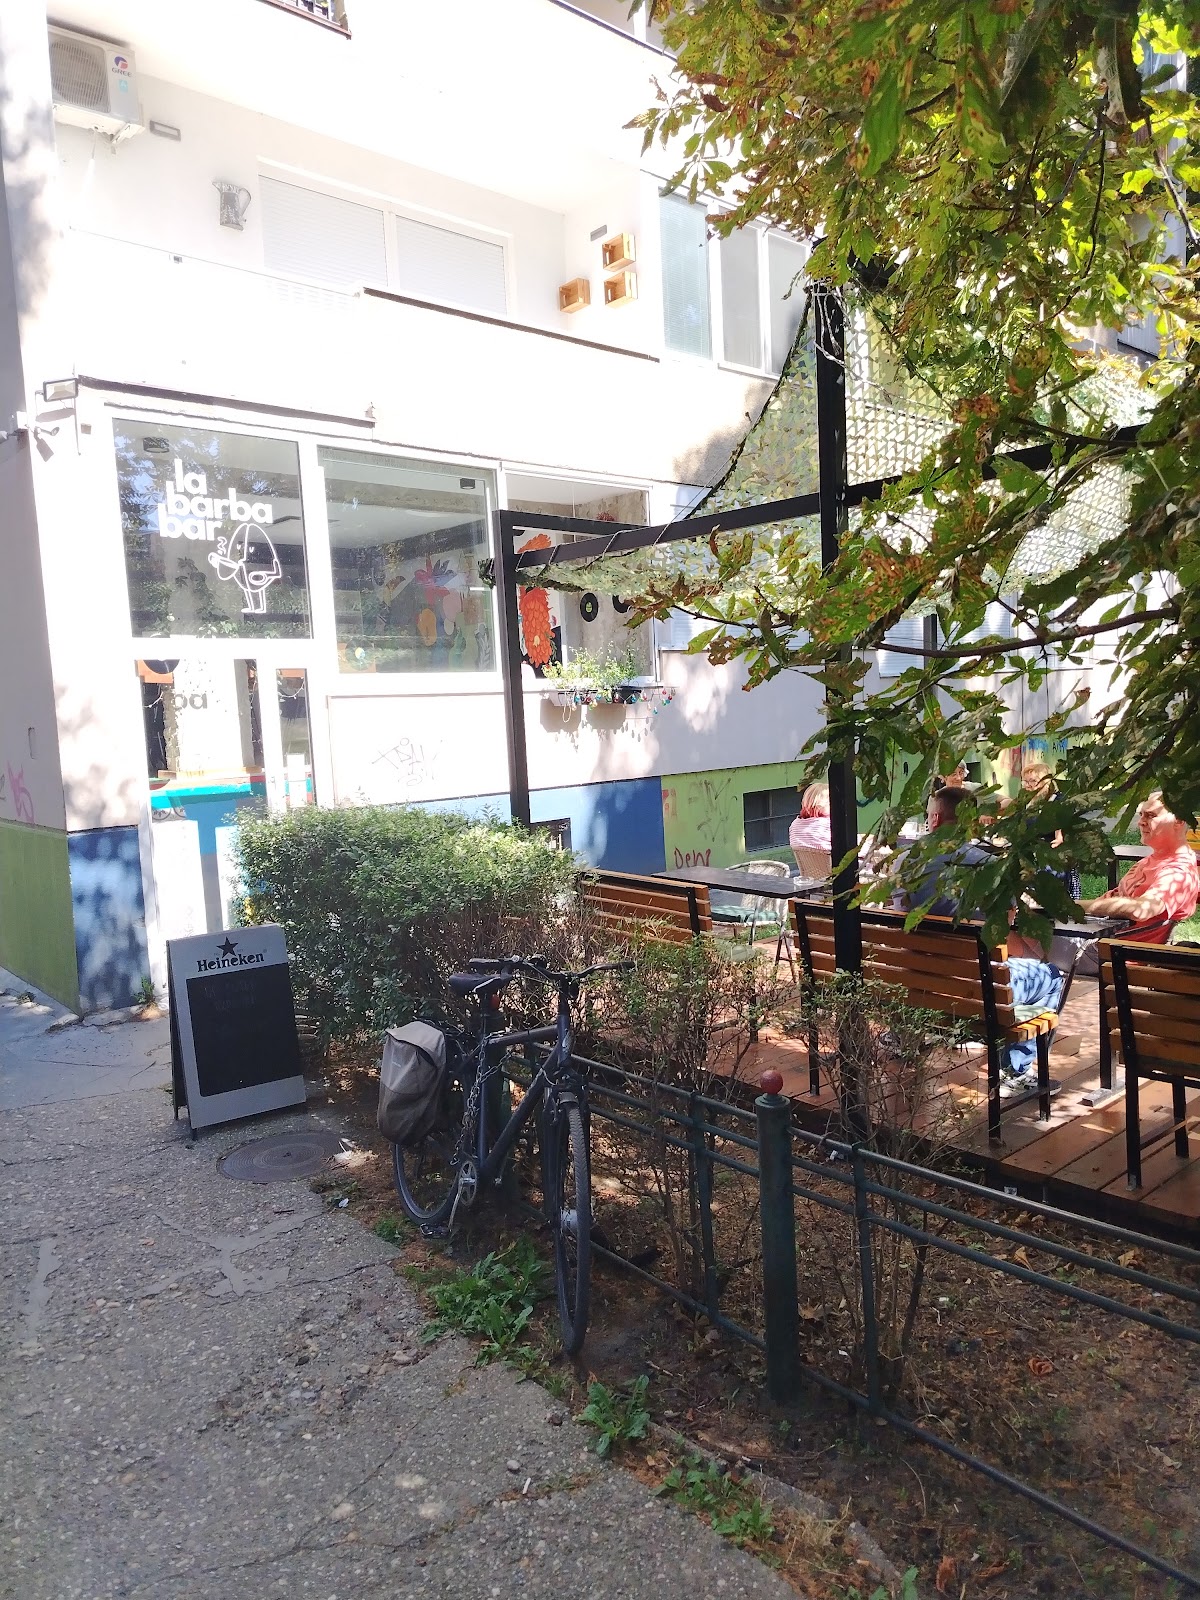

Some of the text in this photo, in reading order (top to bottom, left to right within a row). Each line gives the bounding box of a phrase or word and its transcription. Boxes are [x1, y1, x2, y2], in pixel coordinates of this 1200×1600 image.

[111, 67, 132, 77] GREE
[174, 459, 207, 495] la
[166, 480, 273, 524] barba
[158, 503, 222, 541] bar
[197, 952, 265, 973] Heineken
